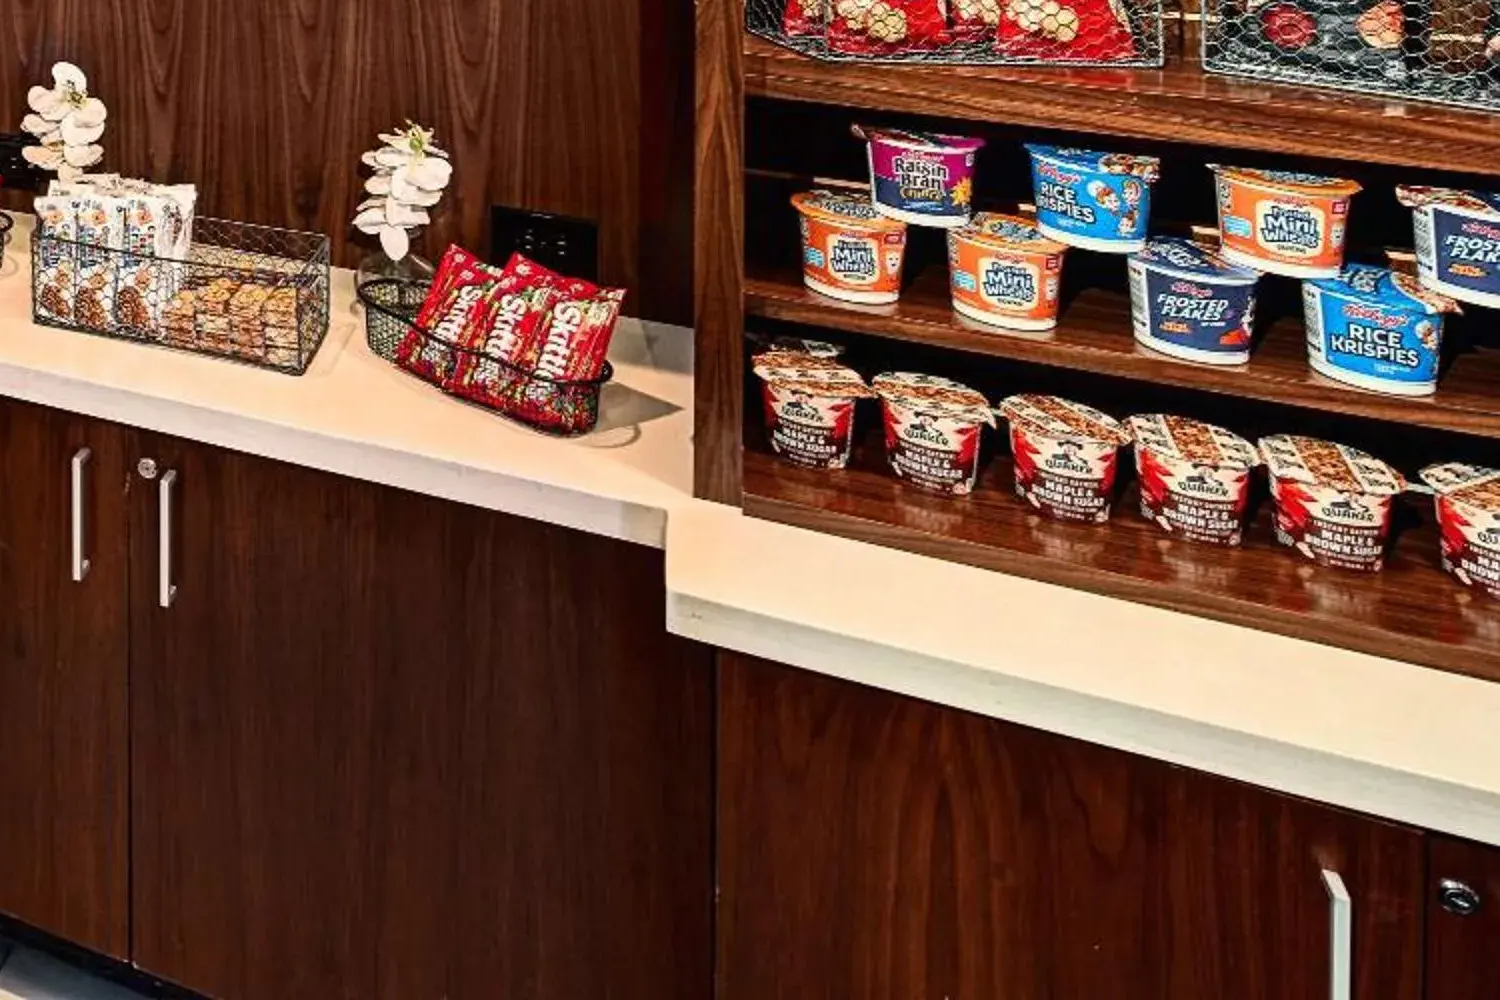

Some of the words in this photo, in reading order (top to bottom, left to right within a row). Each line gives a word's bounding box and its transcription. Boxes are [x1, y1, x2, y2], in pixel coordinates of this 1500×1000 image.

[894, 157, 948, 179] Raisin
[901, 173, 941, 189] Bran
[1041, 182, 1076, 204] RICE
[1265, 214, 1316, 234] Mini
[1262, 228, 1318, 249] Wheats
[834, 247, 873, 263] Mini
[986, 270, 1032, 289] Mini
[1157, 293, 1229, 312] FROSTED
[1161, 305, 1221, 321] FLAKES
[1349, 323, 1402, 348] RICE
[1331, 335, 1419, 367] KRISPIES
